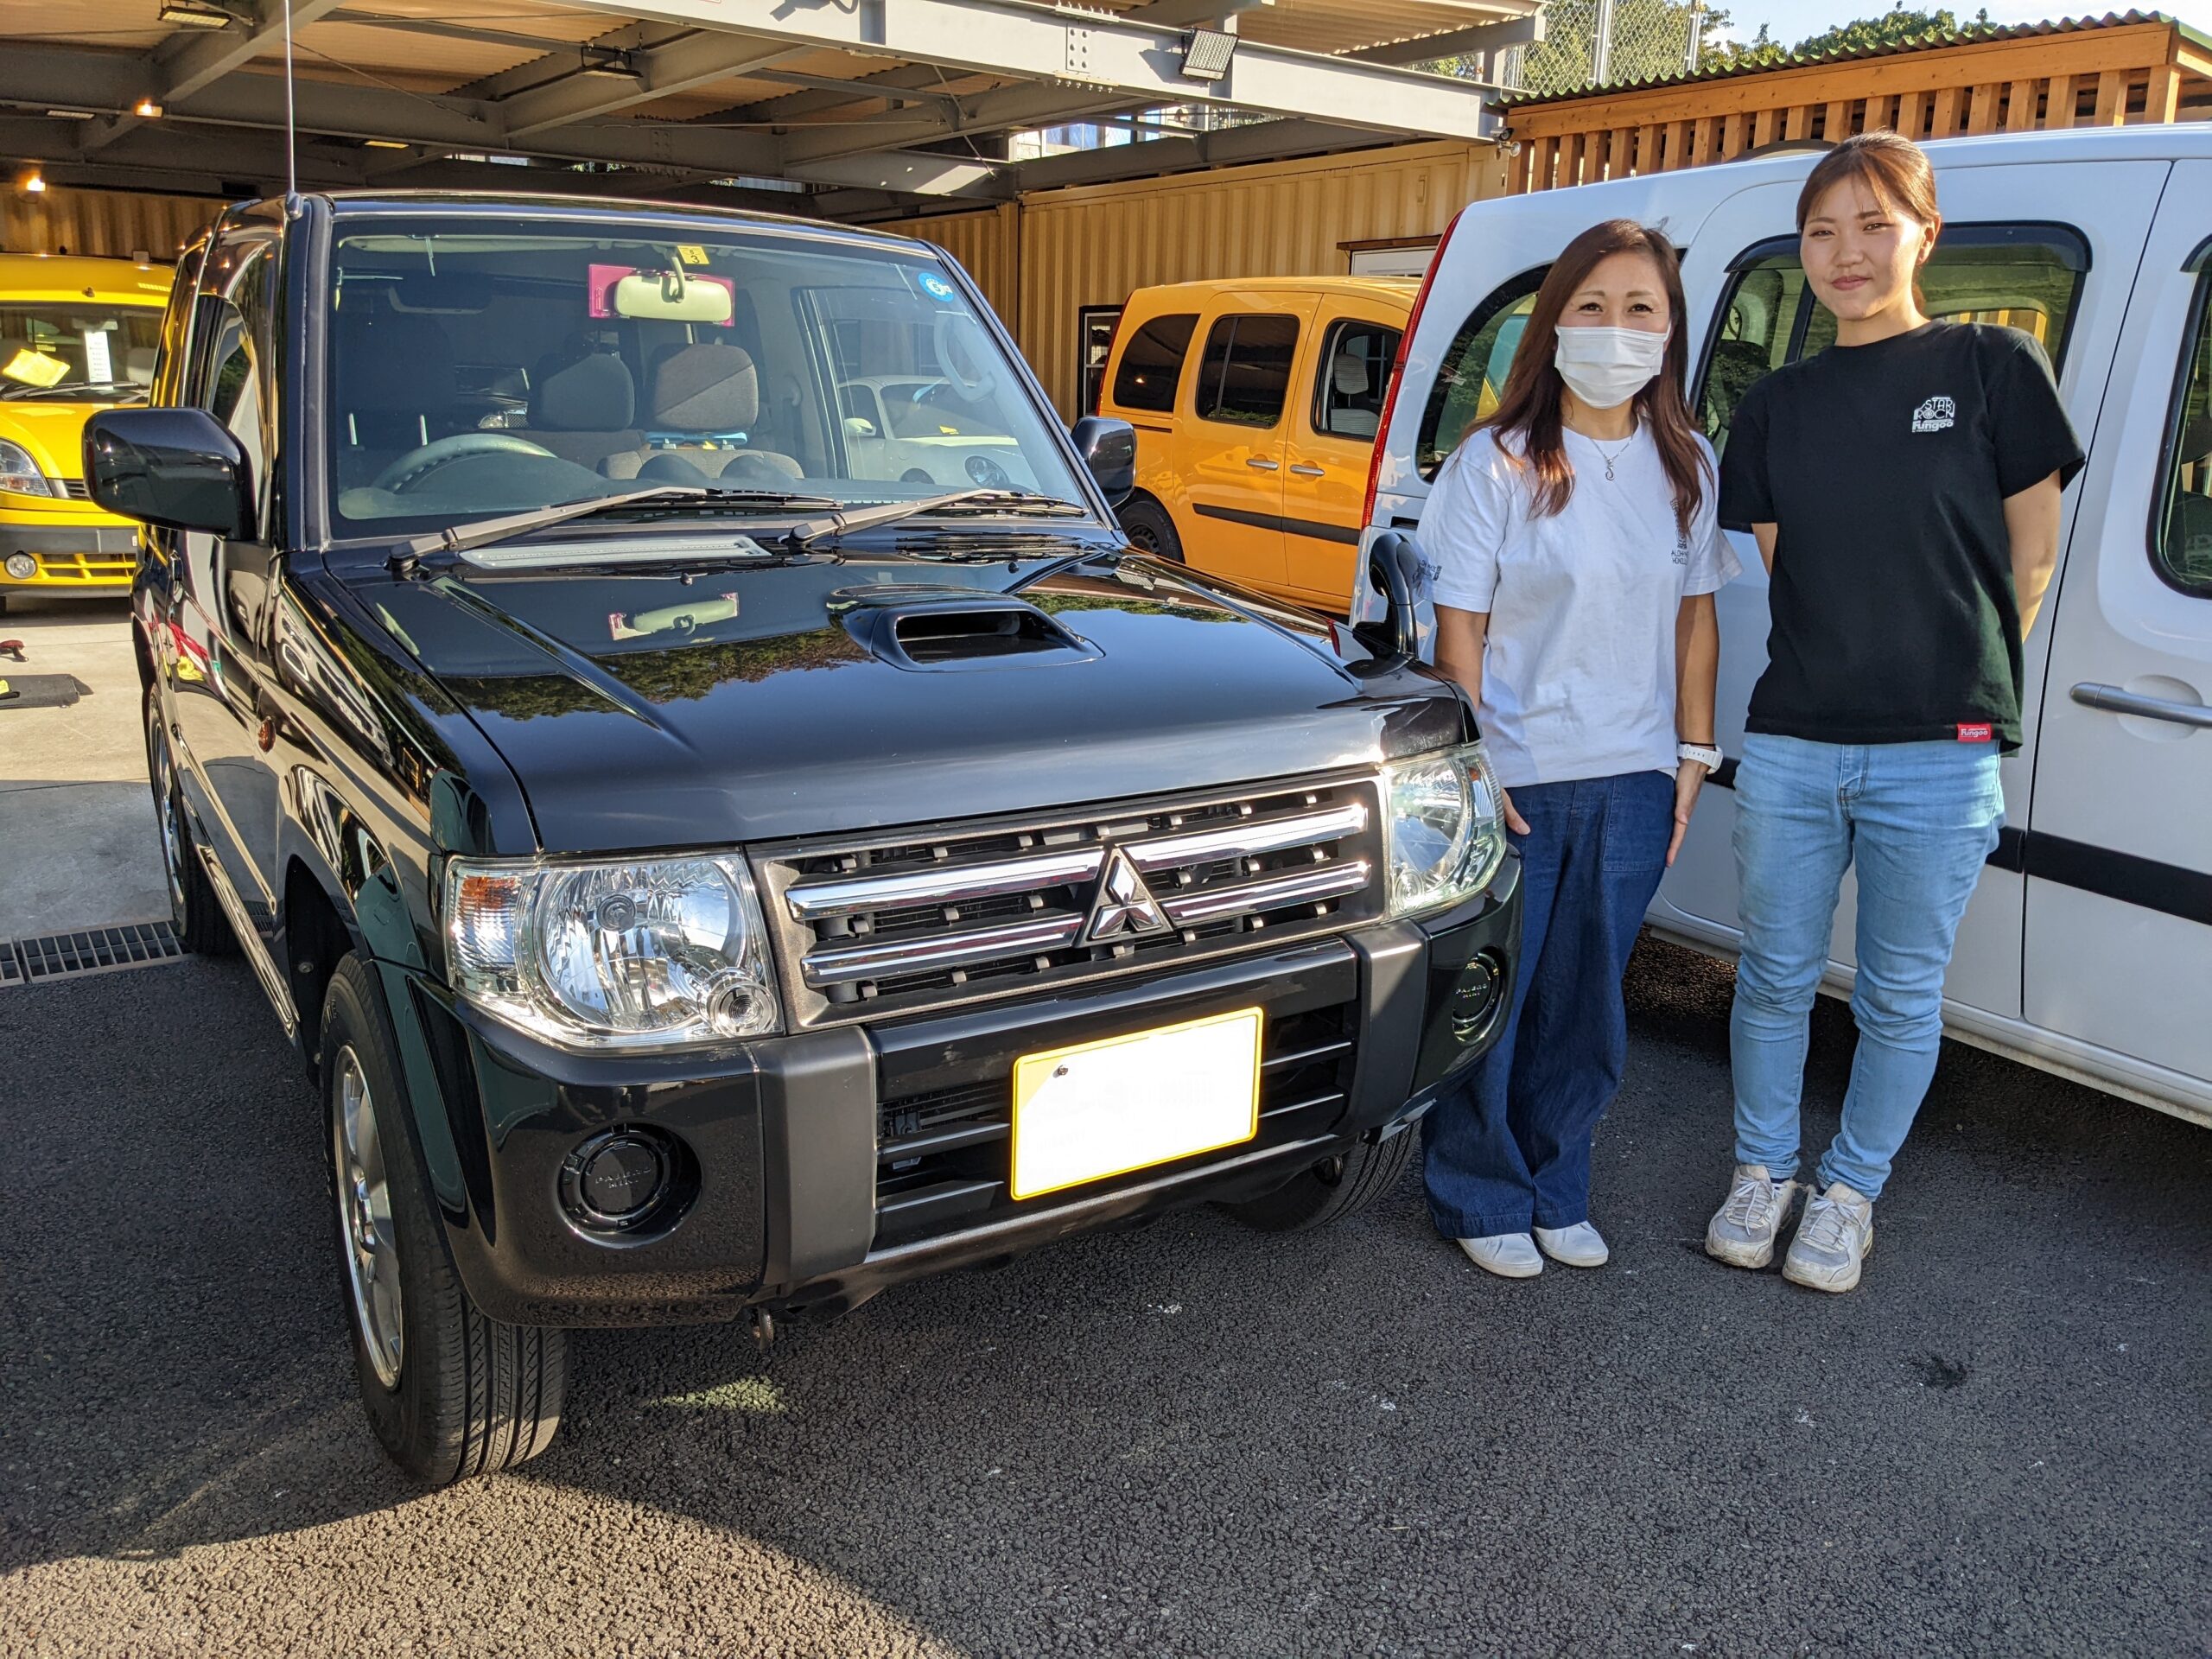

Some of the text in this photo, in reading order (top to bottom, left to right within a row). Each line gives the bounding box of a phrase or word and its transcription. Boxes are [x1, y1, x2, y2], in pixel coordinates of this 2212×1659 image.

[690, 255, 700, 264] 3
[1924, 398, 1954, 410] STAR
[1913, 409, 1955, 420] ROCK
[1912, 420, 1955, 432] Fungoo
[1961, 728, 1988, 738] Fungoo
